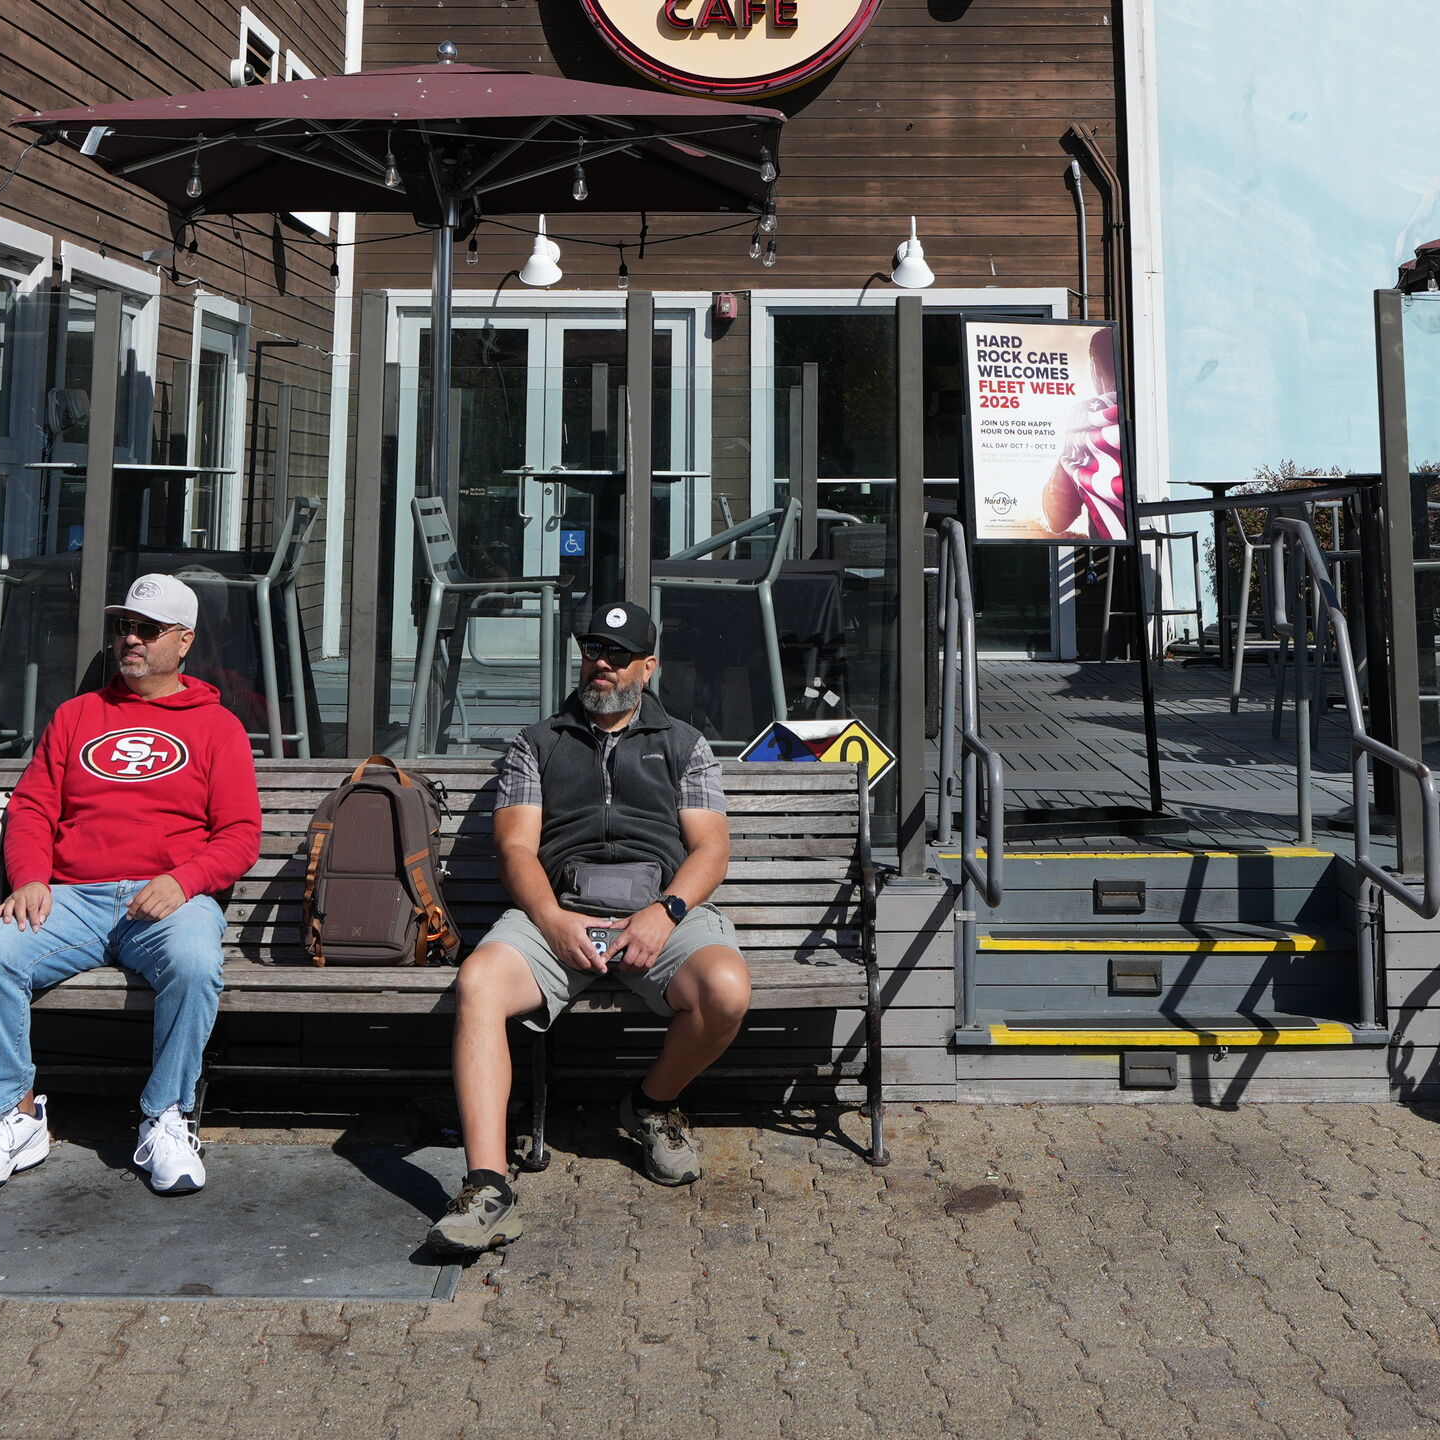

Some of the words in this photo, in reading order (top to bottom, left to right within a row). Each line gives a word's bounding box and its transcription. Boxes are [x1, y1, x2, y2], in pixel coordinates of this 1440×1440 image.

[976, 334, 1022, 348] HARD
[977, 349, 1022, 363] ROCK
[1027, 351, 1068, 365] CAFE
[977, 364, 1069, 380] WELCOMES
[978, 380, 1025, 393] FLEET
[1030, 381, 1076, 395] WEEK
[979, 395, 1020, 408] 2026
[984, 496, 1001, 505] Hard
[1001, 496, 1018, 506] Rock
[111, 736, 169, 775] SF
